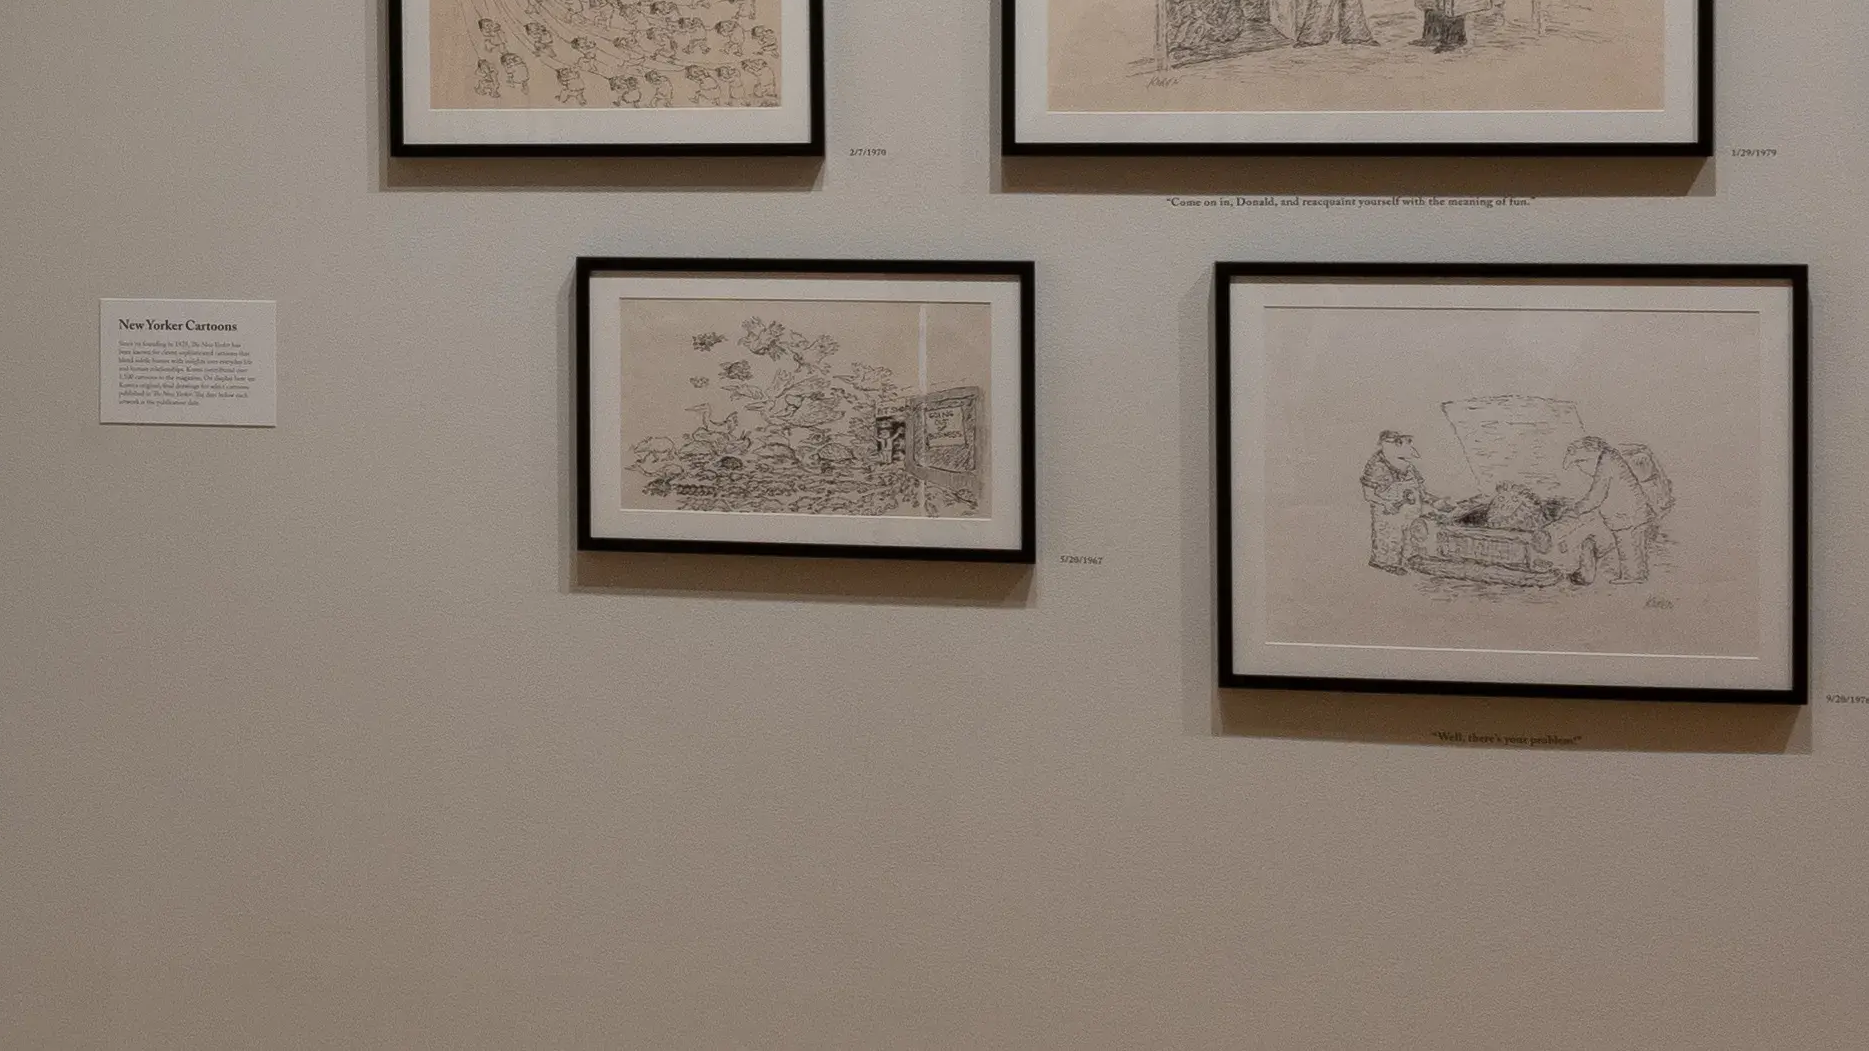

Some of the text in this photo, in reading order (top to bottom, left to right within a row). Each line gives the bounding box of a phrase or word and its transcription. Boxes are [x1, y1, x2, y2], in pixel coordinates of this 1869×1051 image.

[1203, 199, 1217, 207] on
[1219, 197, 1234, 208] in,
[1236, 197, 1278, 208] Donald,
[1280, 197, 1300, 207] and
[1301, 198, 1356, 209] reacquaint
[1358, 197, 1400, 209] yourself
[1402, 197, 1426, 207] with
[1428, 197, 1446, 207] the
[1448, 198, 1493, 210] meaning
[119, 319, 238, 332] New Yorker Cartoons
